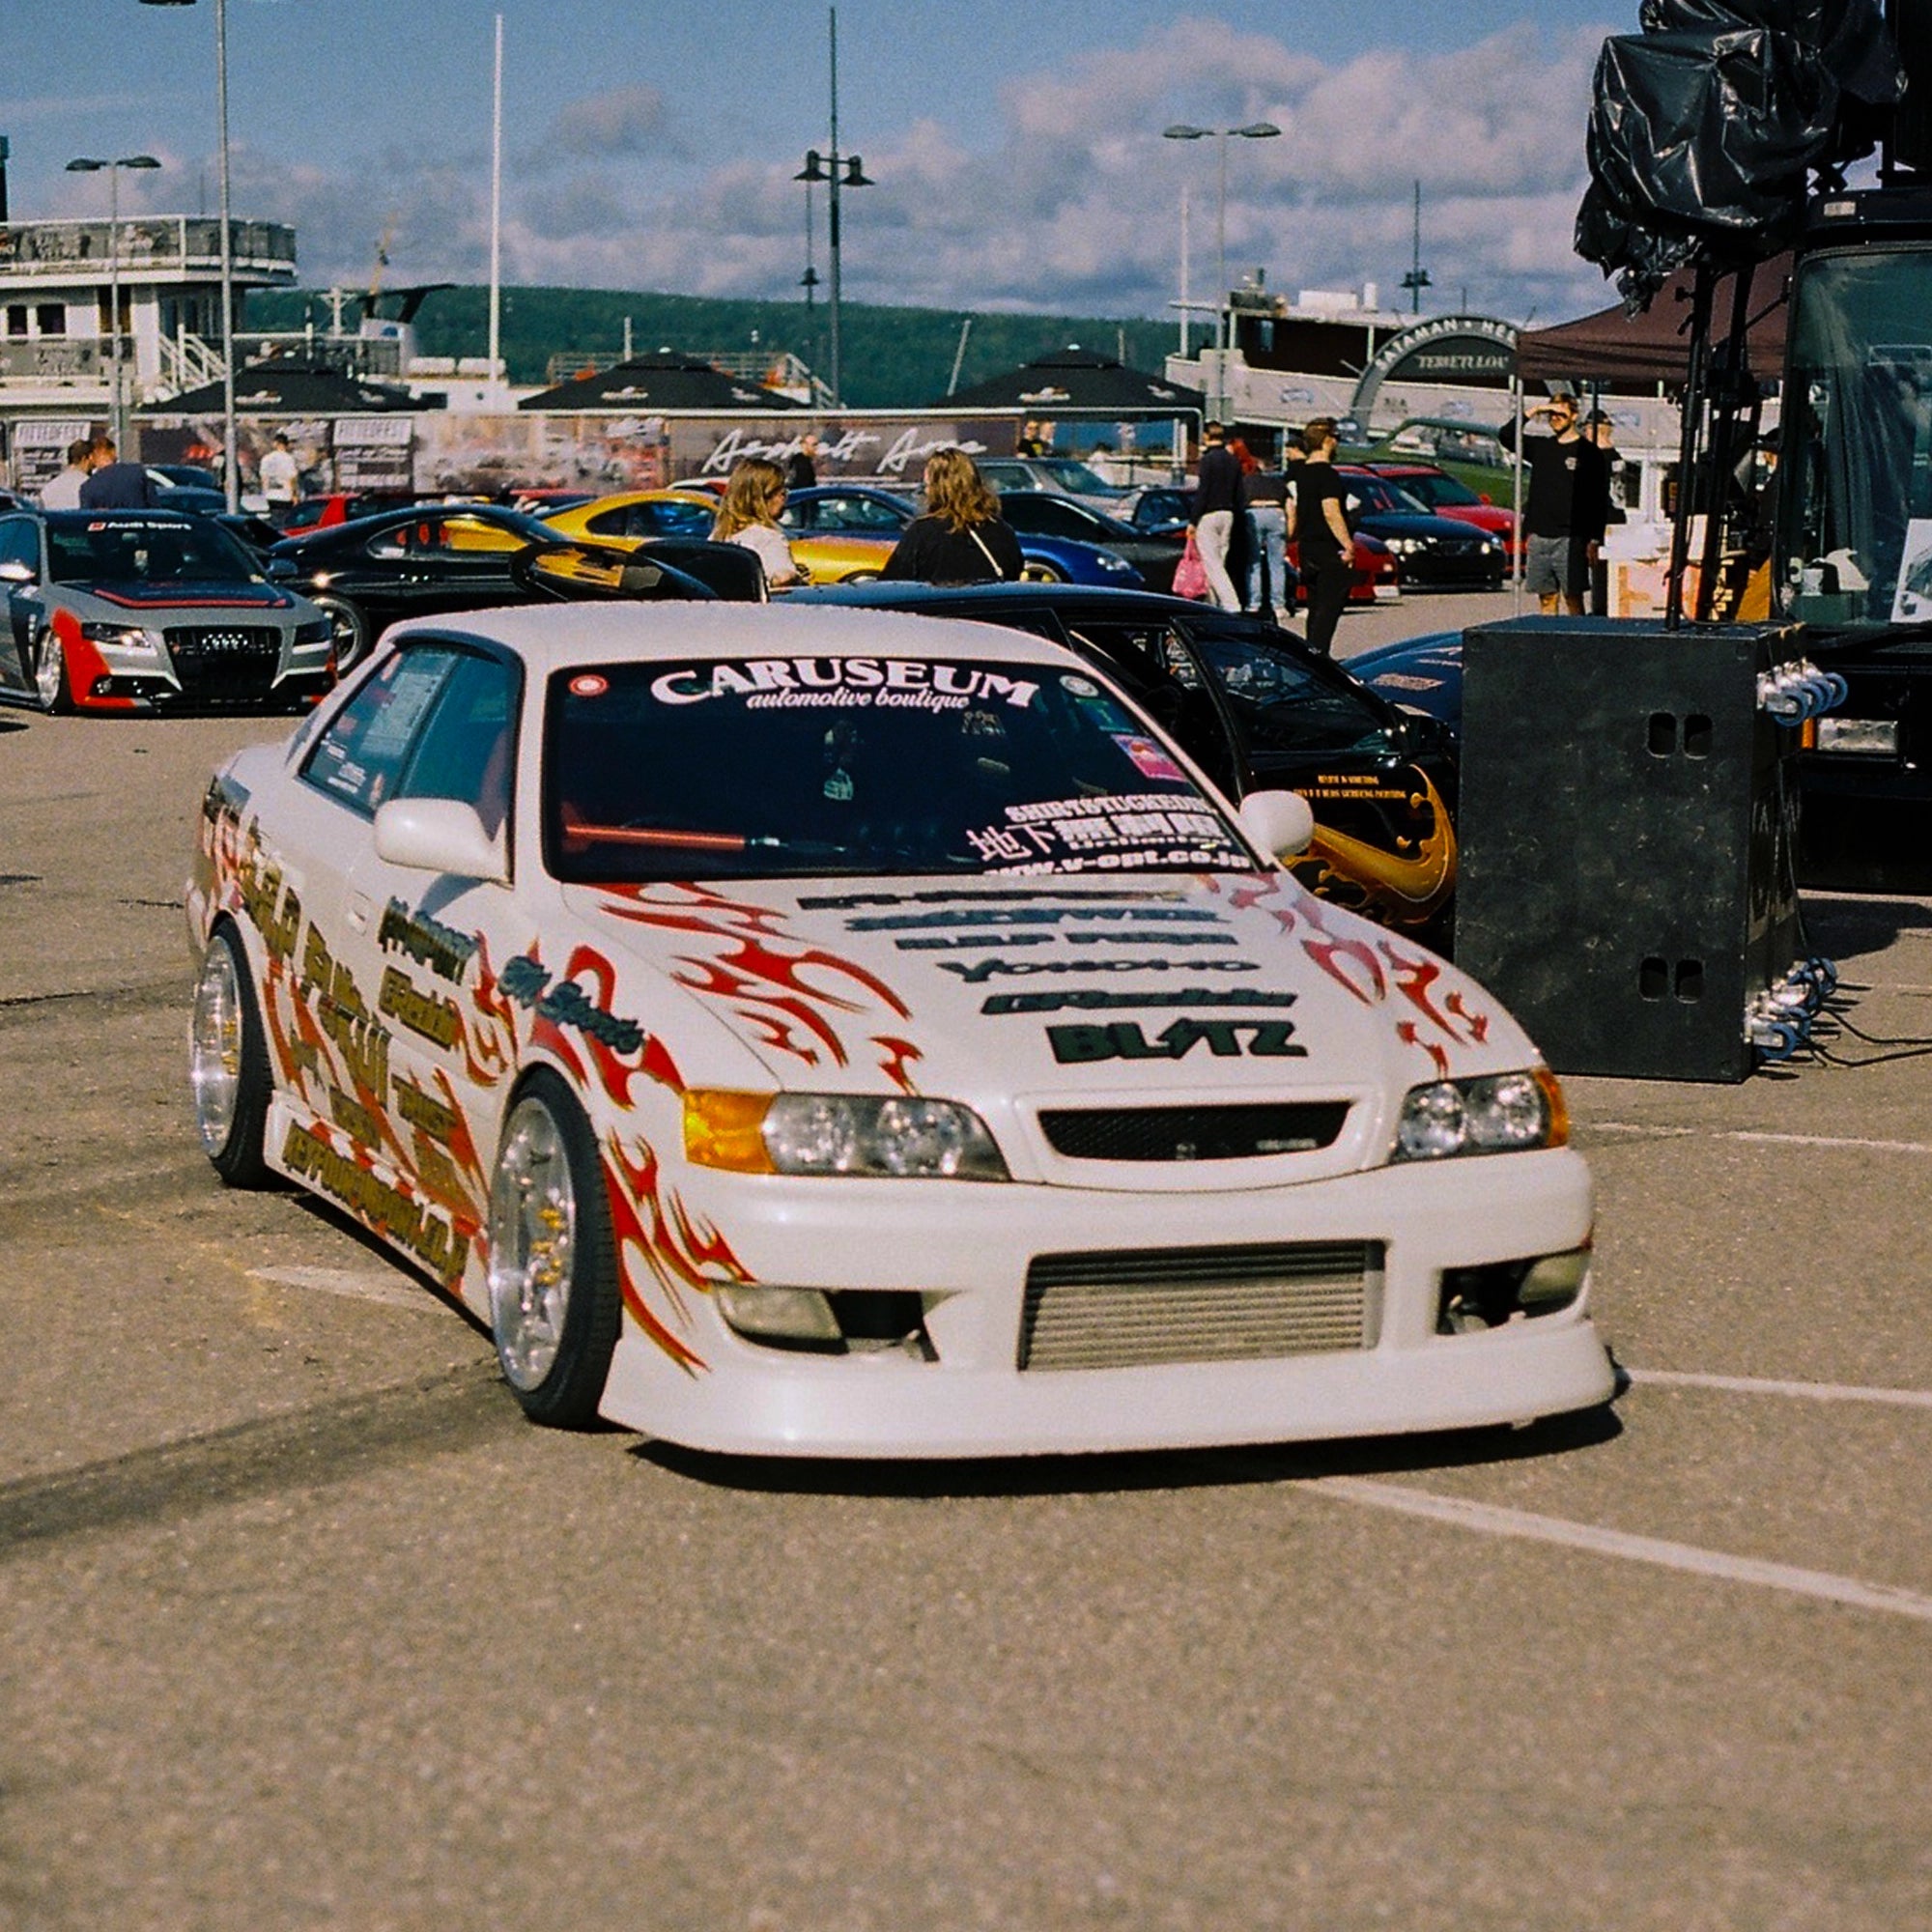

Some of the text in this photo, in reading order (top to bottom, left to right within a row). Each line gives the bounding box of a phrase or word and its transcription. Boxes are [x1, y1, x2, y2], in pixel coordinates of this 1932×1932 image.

[650, 658, 1040, 707] CARUSEUM
[746, 687, 969, 713] automotive boutique
[1045, 1017, 1309, 1064] BLITZ
